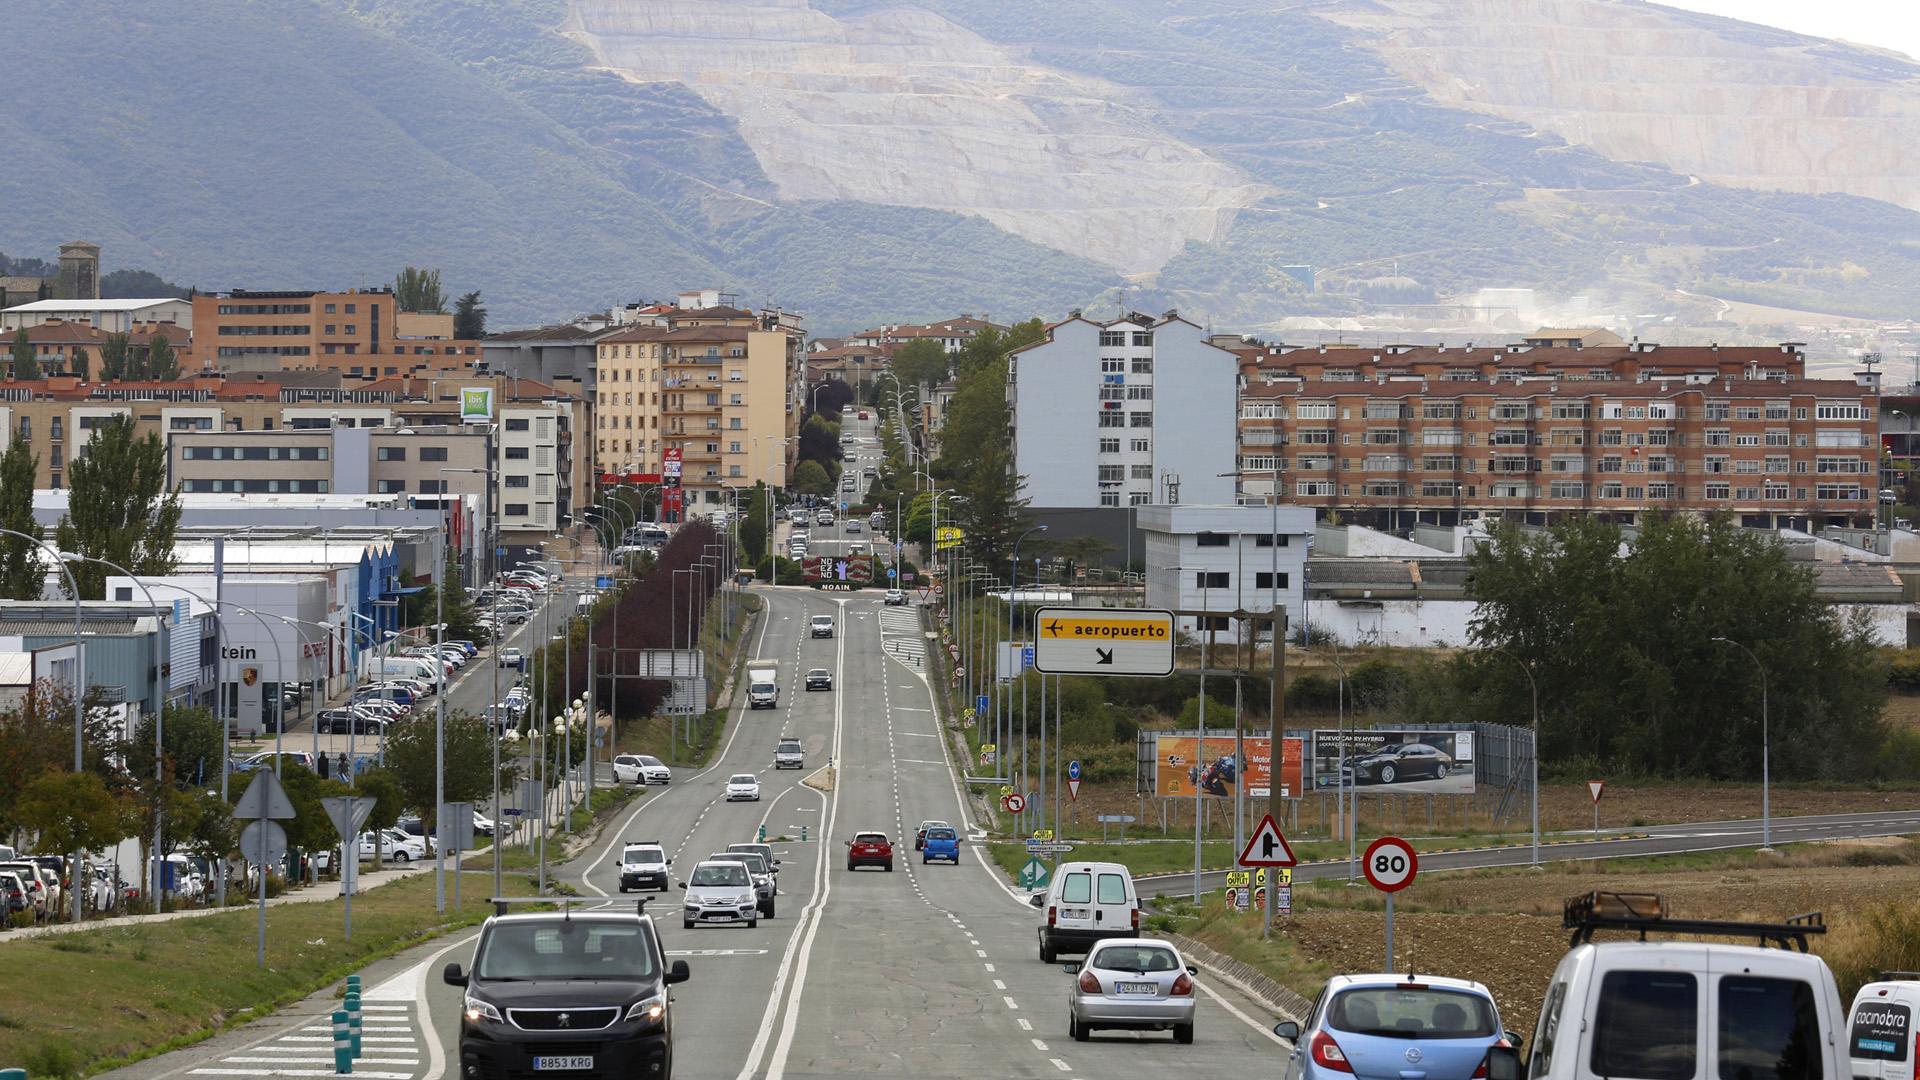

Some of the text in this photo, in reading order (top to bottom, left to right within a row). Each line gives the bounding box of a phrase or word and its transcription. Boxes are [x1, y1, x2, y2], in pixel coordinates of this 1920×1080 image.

[468, 395, 483, 403] ibis
[1075, 624, 1165, 638] aeropuerto
[1375, 855, 1405, 873] 80
[1856, 1009, 1905, 1027] cocinobra
[541, 1057, 591, 1068] 8853 KRG
